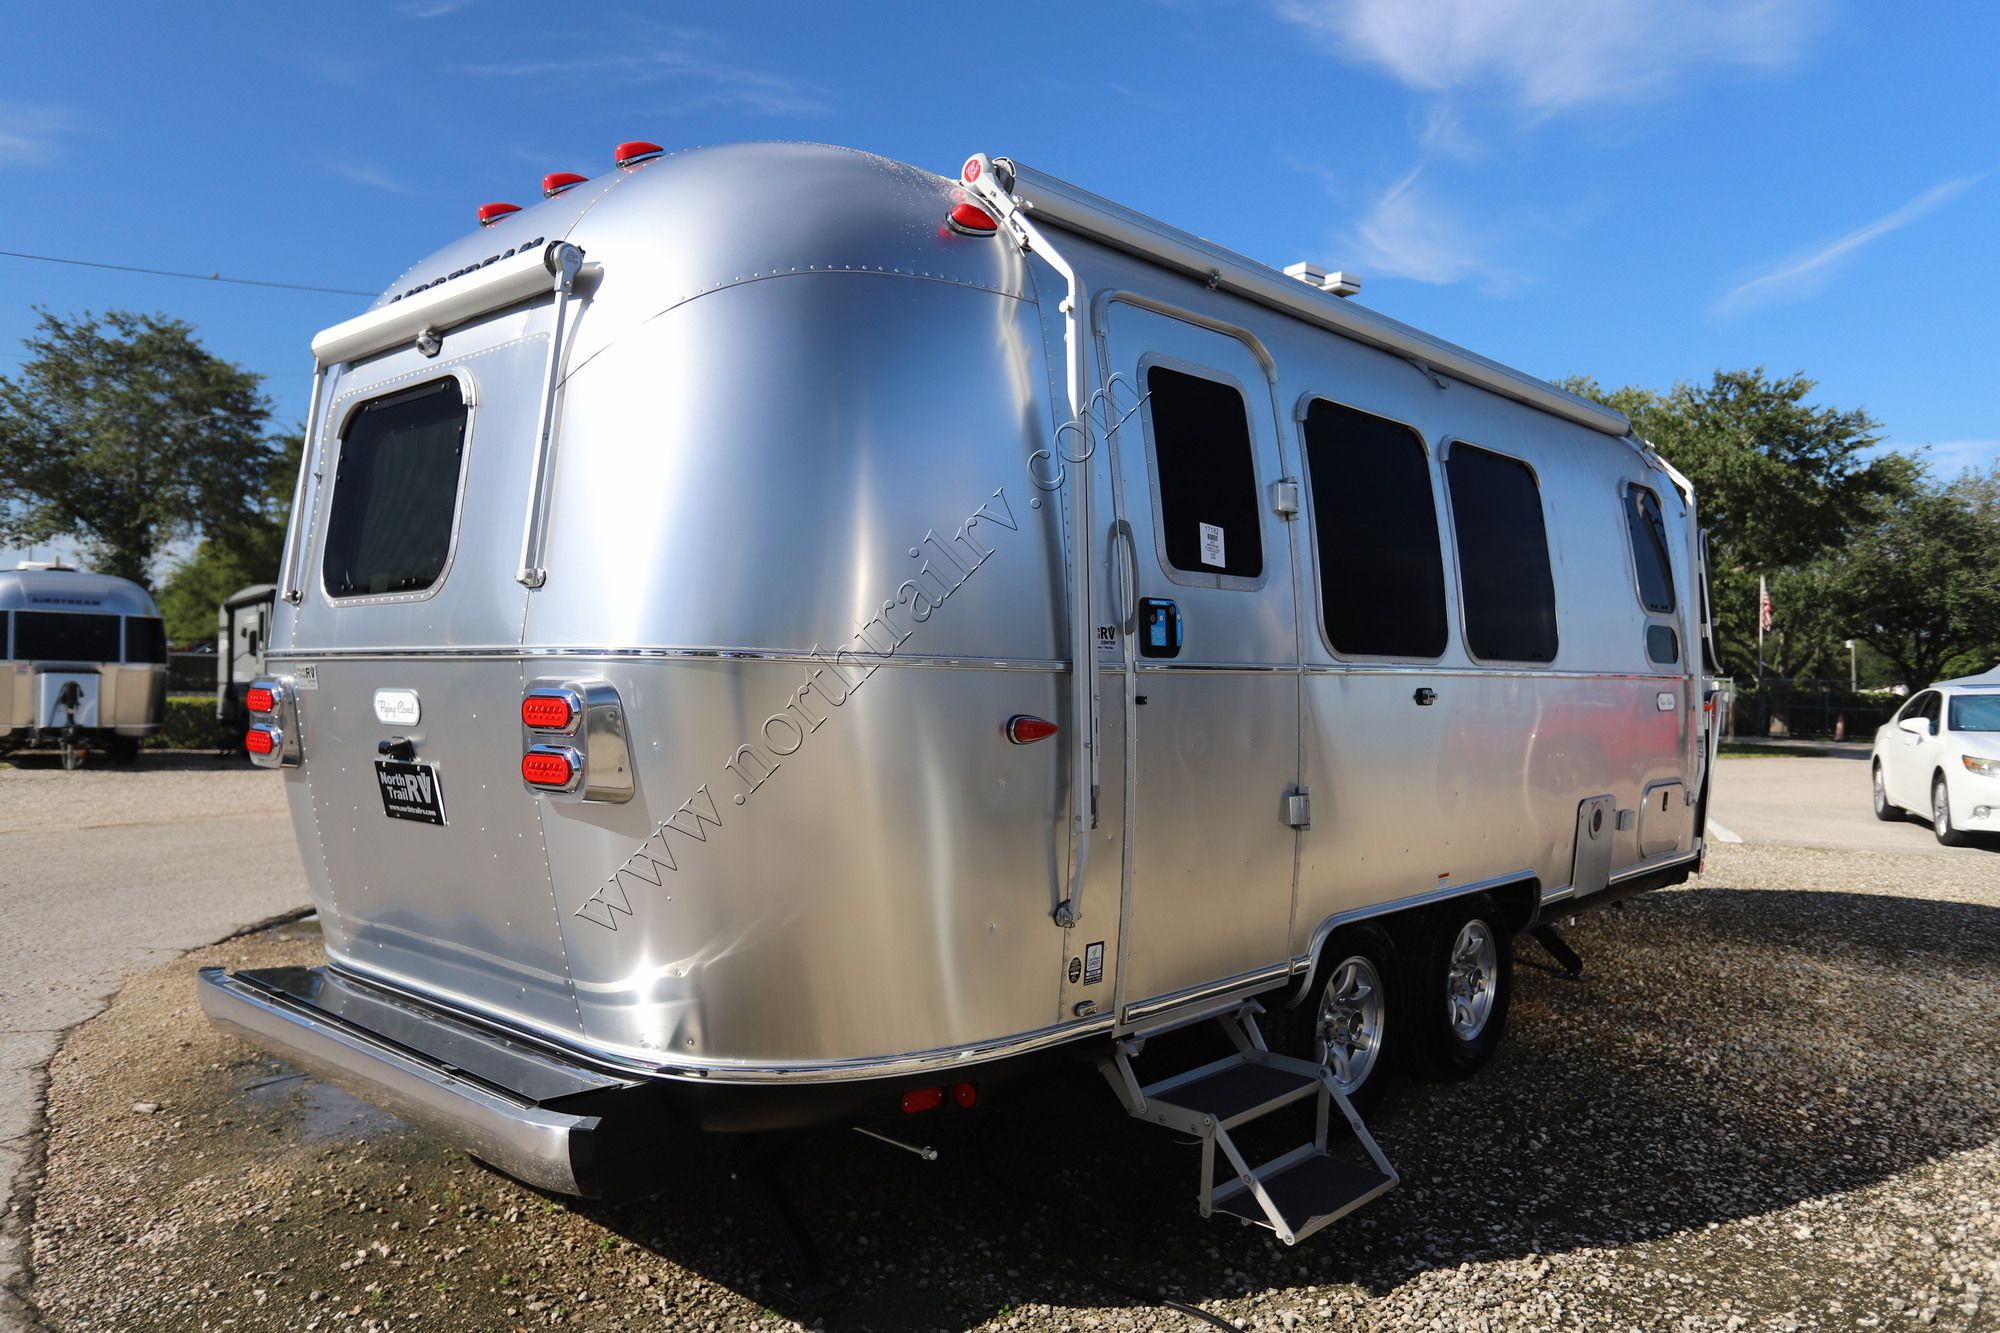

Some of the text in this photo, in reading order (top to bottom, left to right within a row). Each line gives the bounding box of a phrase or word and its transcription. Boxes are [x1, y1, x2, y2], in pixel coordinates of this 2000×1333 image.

[31, 597, 102, 606] AIRSTREAM
[1100, 625, 1115, 640] RV
[305, 666, 315, 679] RV
[380, 771, 406, 787] North
[387, 786, 409, 801] Trail
[404, 772, 431, 804] RV
